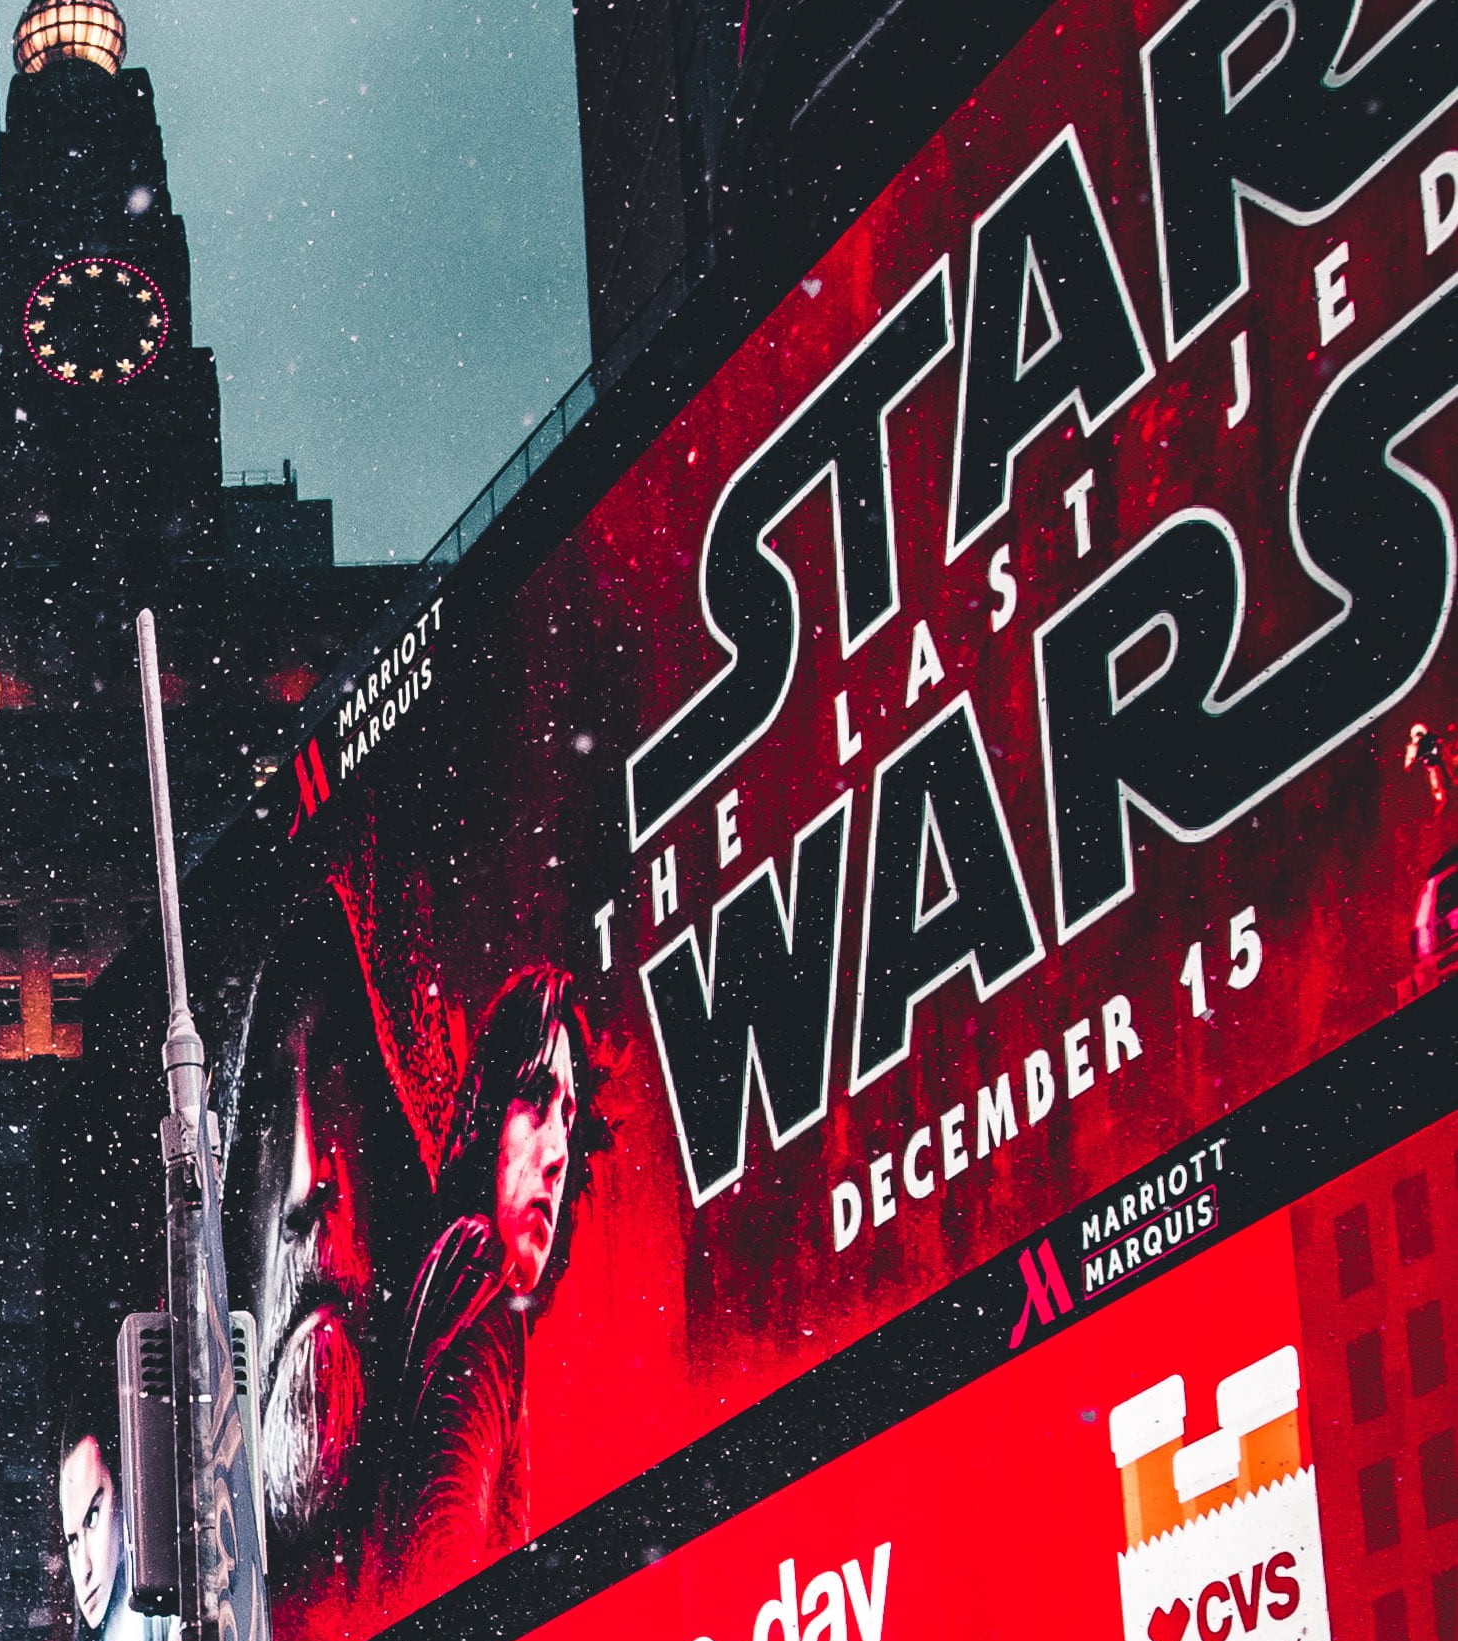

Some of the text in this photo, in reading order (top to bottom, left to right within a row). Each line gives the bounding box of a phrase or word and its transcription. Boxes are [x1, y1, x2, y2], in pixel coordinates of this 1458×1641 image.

[337, 594, 445, 737] MARRIOTT
[339, 657, 434, 781] MARQUIS
[594, 788, 739, 972] THE
[835, 468, 1095, 767] LAST
[639, 273, 1458, 1208] WARS
[831, 905, 1263, 1254] DECEMBER 15
[1082, 1138, 1227, 1250] MARRIOTT
[1085, 1194, 1213, 1292] MARQUIS
